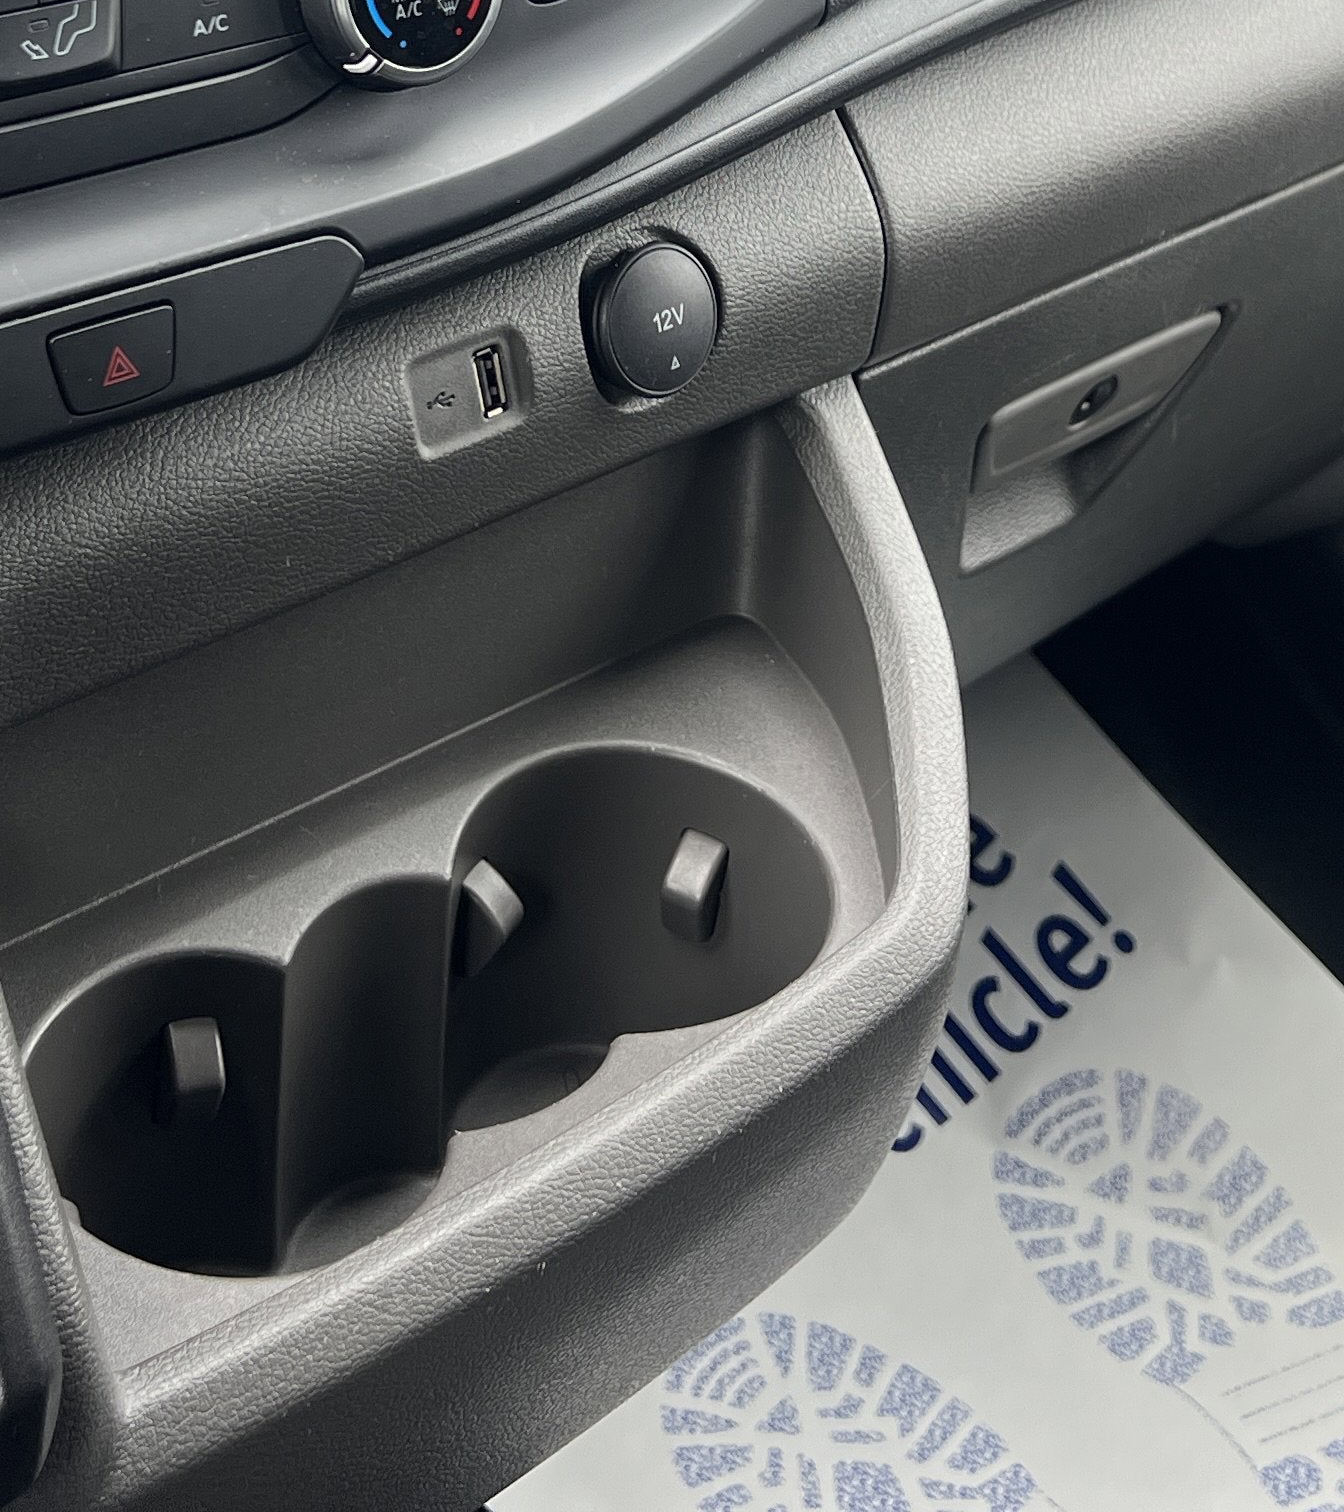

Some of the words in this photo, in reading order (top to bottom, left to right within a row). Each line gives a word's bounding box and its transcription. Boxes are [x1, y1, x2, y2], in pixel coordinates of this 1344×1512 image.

[396, 0, 423, 20] A/C
[193, 13, 229, 38] A/C
[652, 303, 687, 335] 12V
